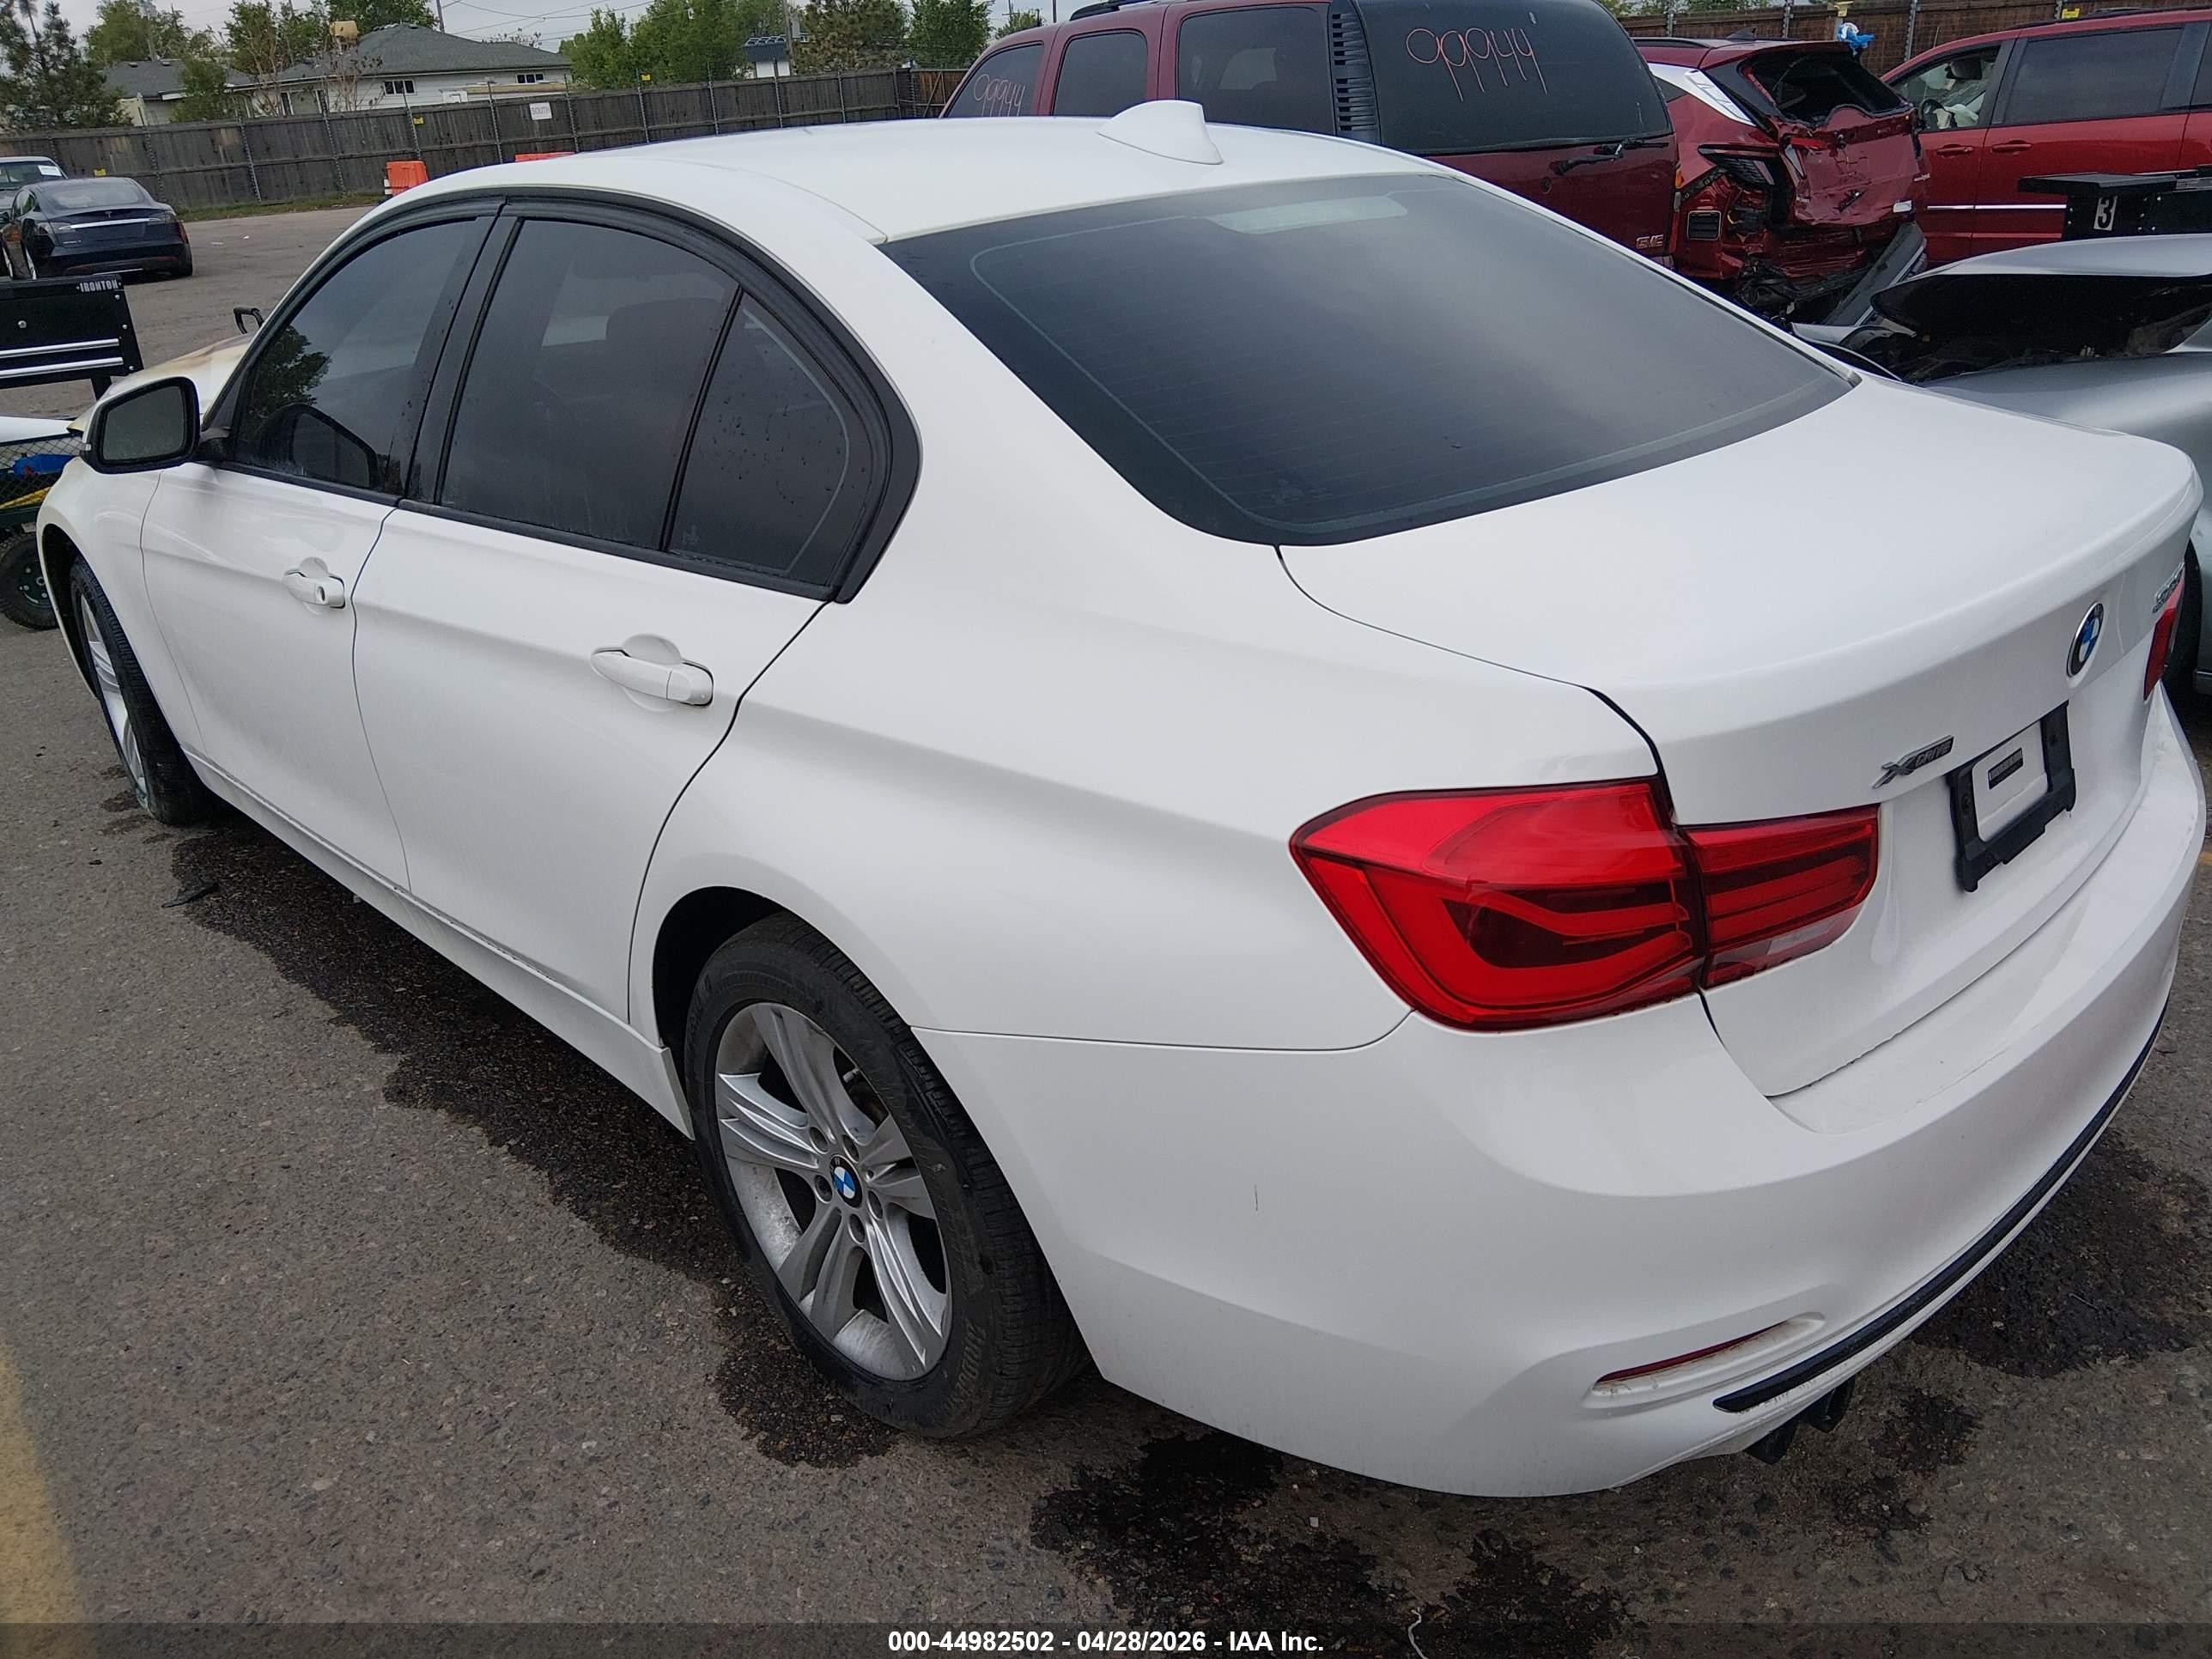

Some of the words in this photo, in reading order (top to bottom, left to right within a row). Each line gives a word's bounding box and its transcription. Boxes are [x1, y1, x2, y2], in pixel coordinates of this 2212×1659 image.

[1406, 27, 1548, 102] 99944
[532, 106, 550, 115] SOUTH
[2097, 195, 2113, 228] 3
[79, 279, 118, 293] IRONTON
